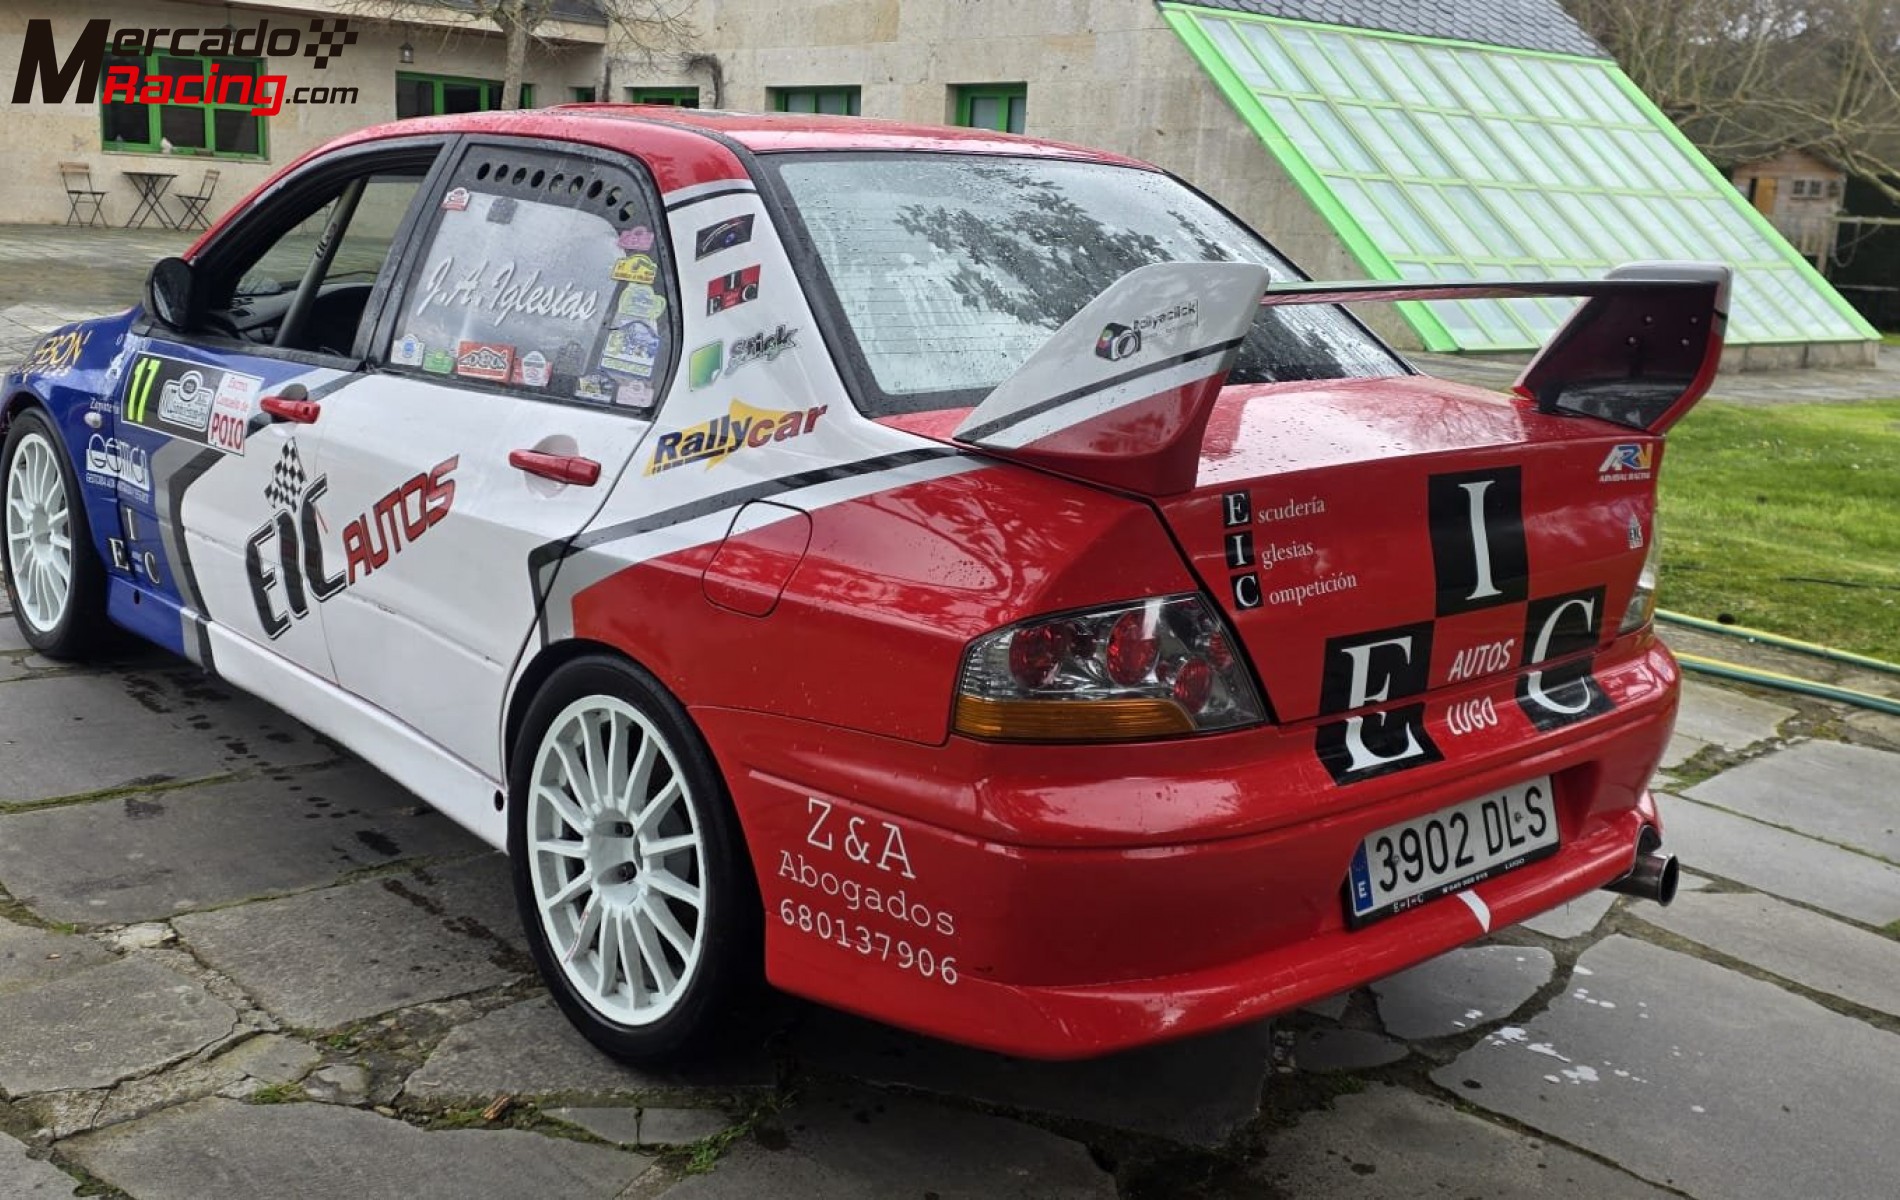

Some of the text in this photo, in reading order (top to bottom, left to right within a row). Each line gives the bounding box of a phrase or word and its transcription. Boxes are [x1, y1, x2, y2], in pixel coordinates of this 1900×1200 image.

[488, 258, 598, 327] Iglesias
[211, 412, 244, 449] POIO
[653, 404, 828, 465] Rallycar
[1226, 493, 1326, 526] E scudería
[109, 537, 130, 571] E
[246, 454, 460, 641] EIC AUTOS
[1231, 535, 1316, 570] I glesias
[1458, 480, 1503, 601] I
[1235, 572, 1358, 608] C ompetición
[1447, 638, 1516, 682] AUTOS
[1526, 598, 1596, 714] C
[1341, 635, 1424, 772] E
[1446, 696, 1498, 736] LUGO
[1376, 786, 1547, 892] 3902 DLS
[778, 850, 954, 936] Abogados
[1358, 882, 1367, 898] E
[780, 898, 958, 985] 680137906
